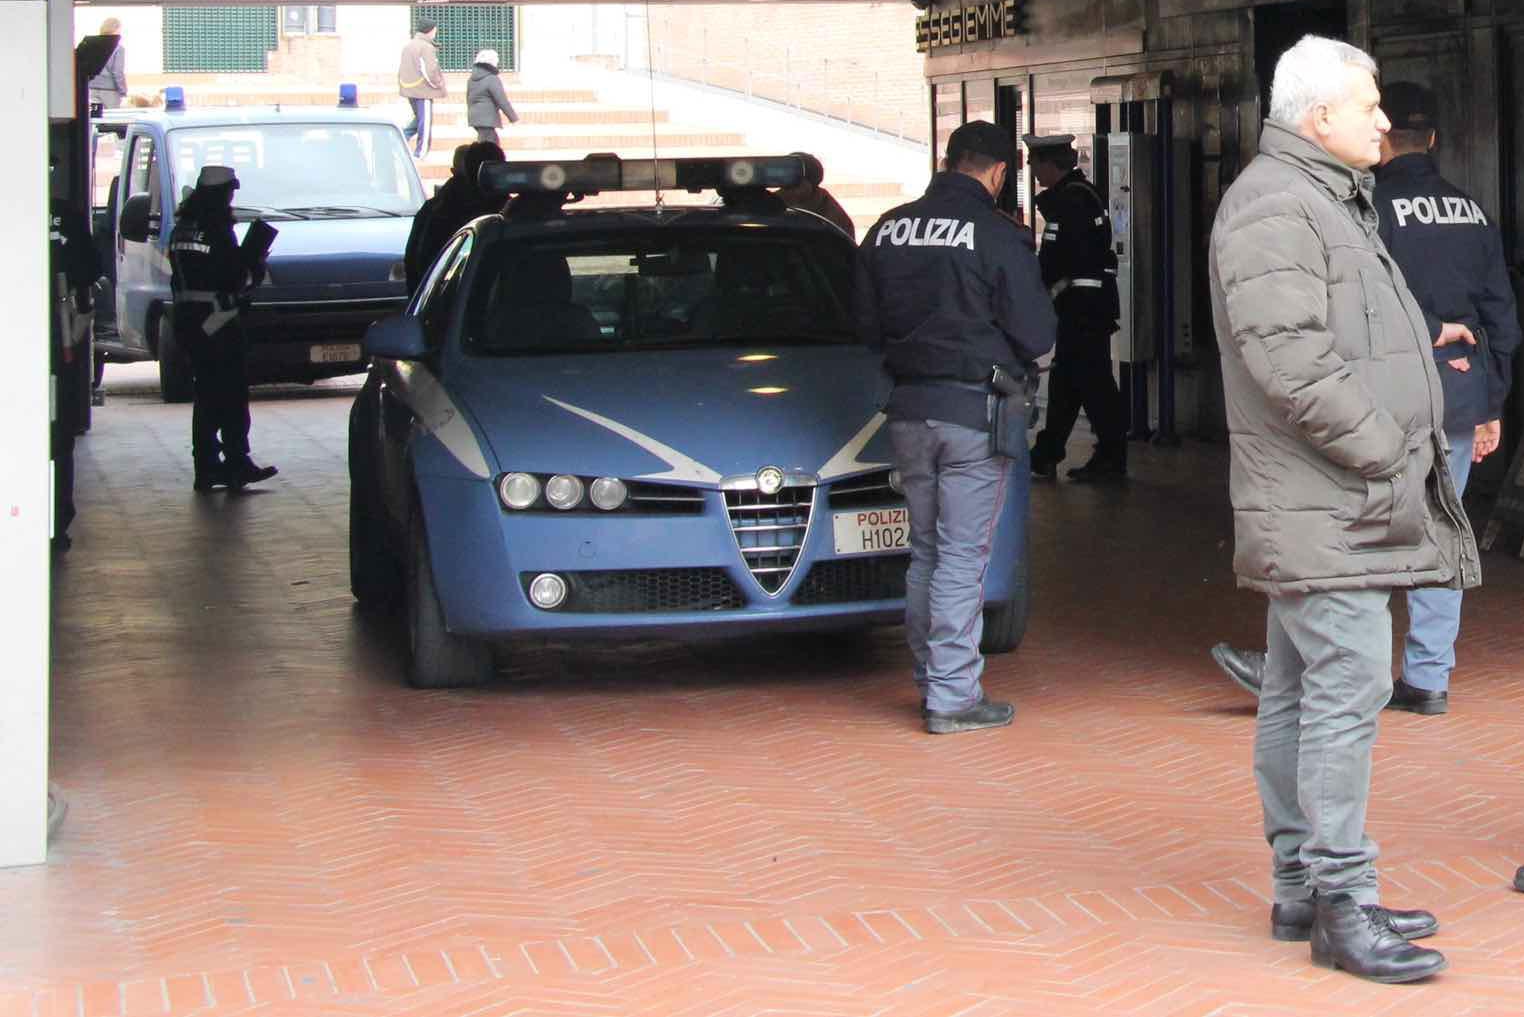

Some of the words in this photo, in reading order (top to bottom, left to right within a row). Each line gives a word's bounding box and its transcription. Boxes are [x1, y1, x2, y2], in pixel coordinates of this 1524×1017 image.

[915, 0, 1017, 52] ESSEGIEMME
[1391, 195, 1488, 227] POLIZIA
[875, 217, 976, 251] POLIZIA
[857, 510, 906, 526] POLIZI
[862, 527, 912, 550] H102
